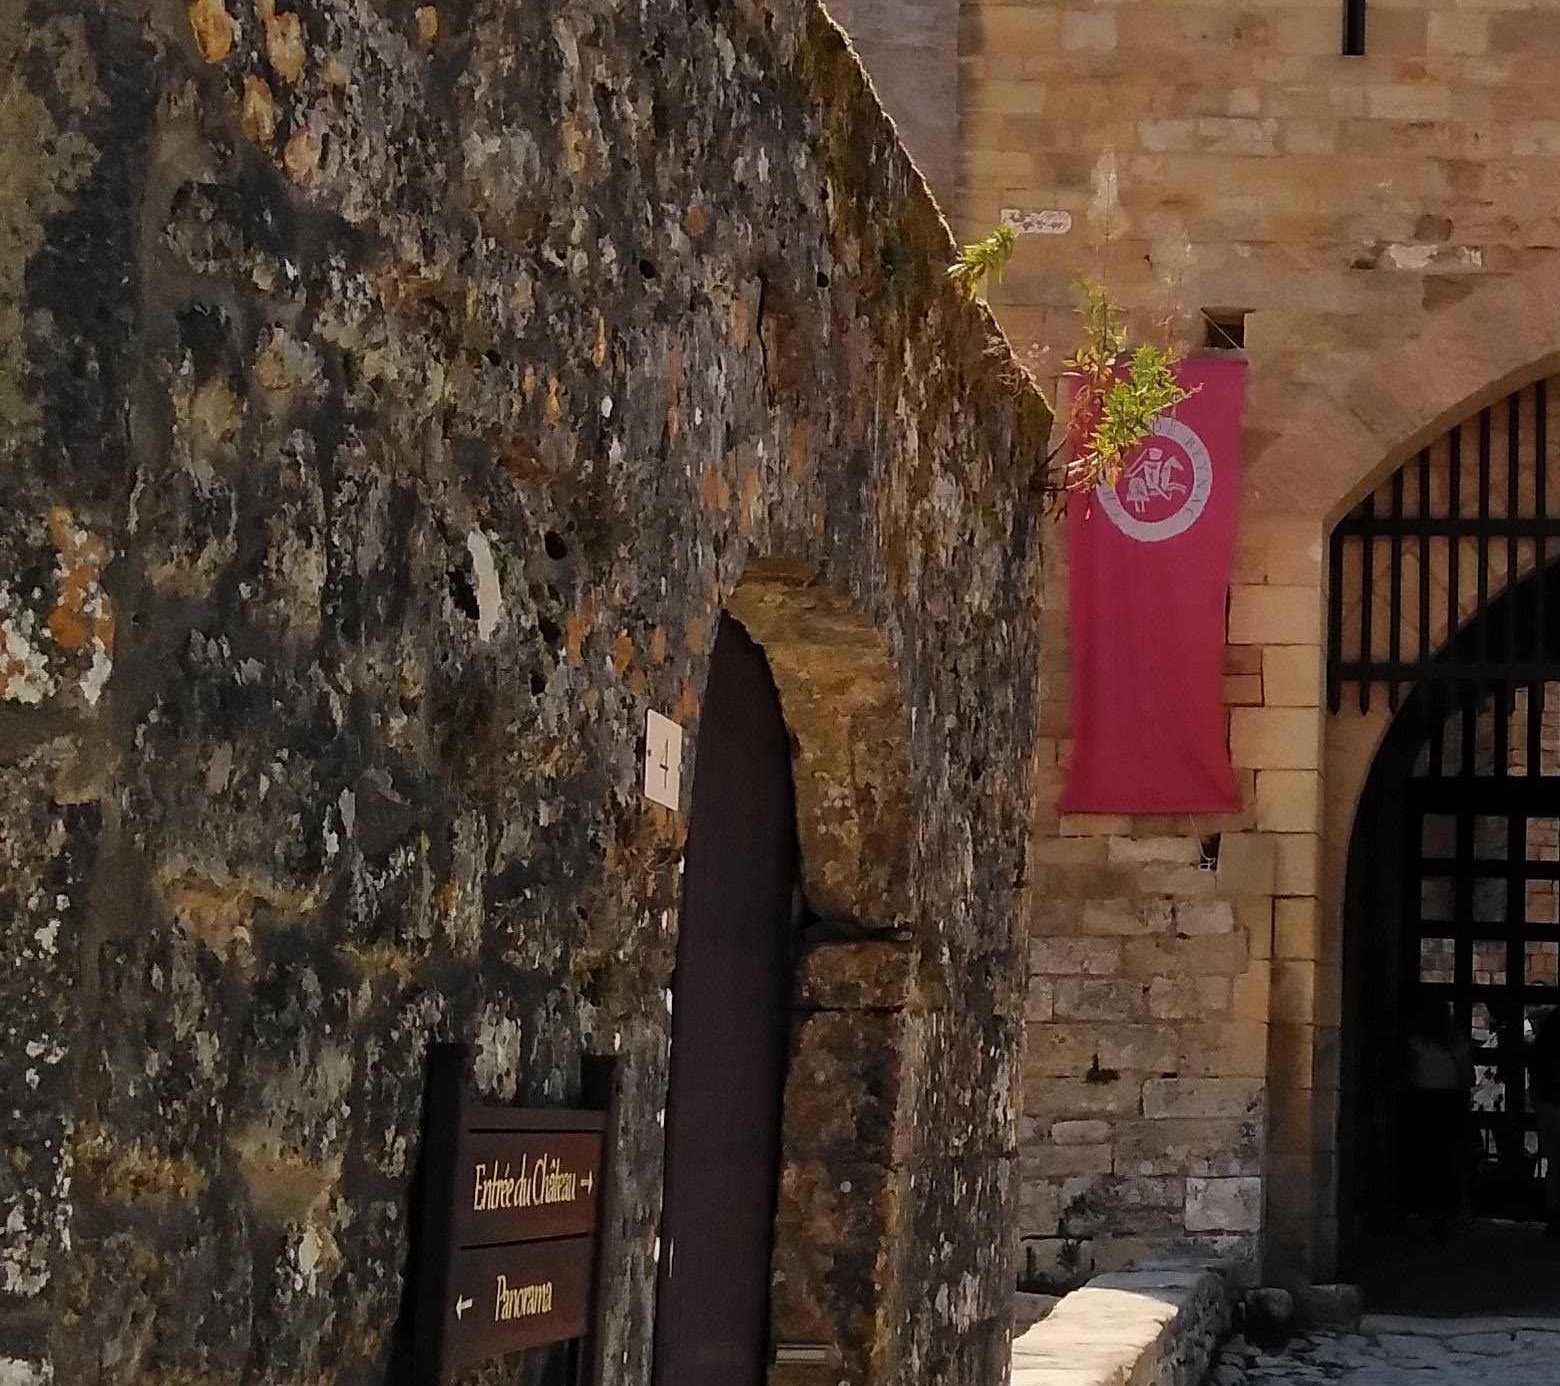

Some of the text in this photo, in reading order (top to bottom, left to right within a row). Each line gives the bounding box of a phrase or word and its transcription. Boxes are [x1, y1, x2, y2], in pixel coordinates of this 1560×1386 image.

[473, 1153, 576, 1211] Entrée du Château
[495, 1274, 553, 1321] Panorama
